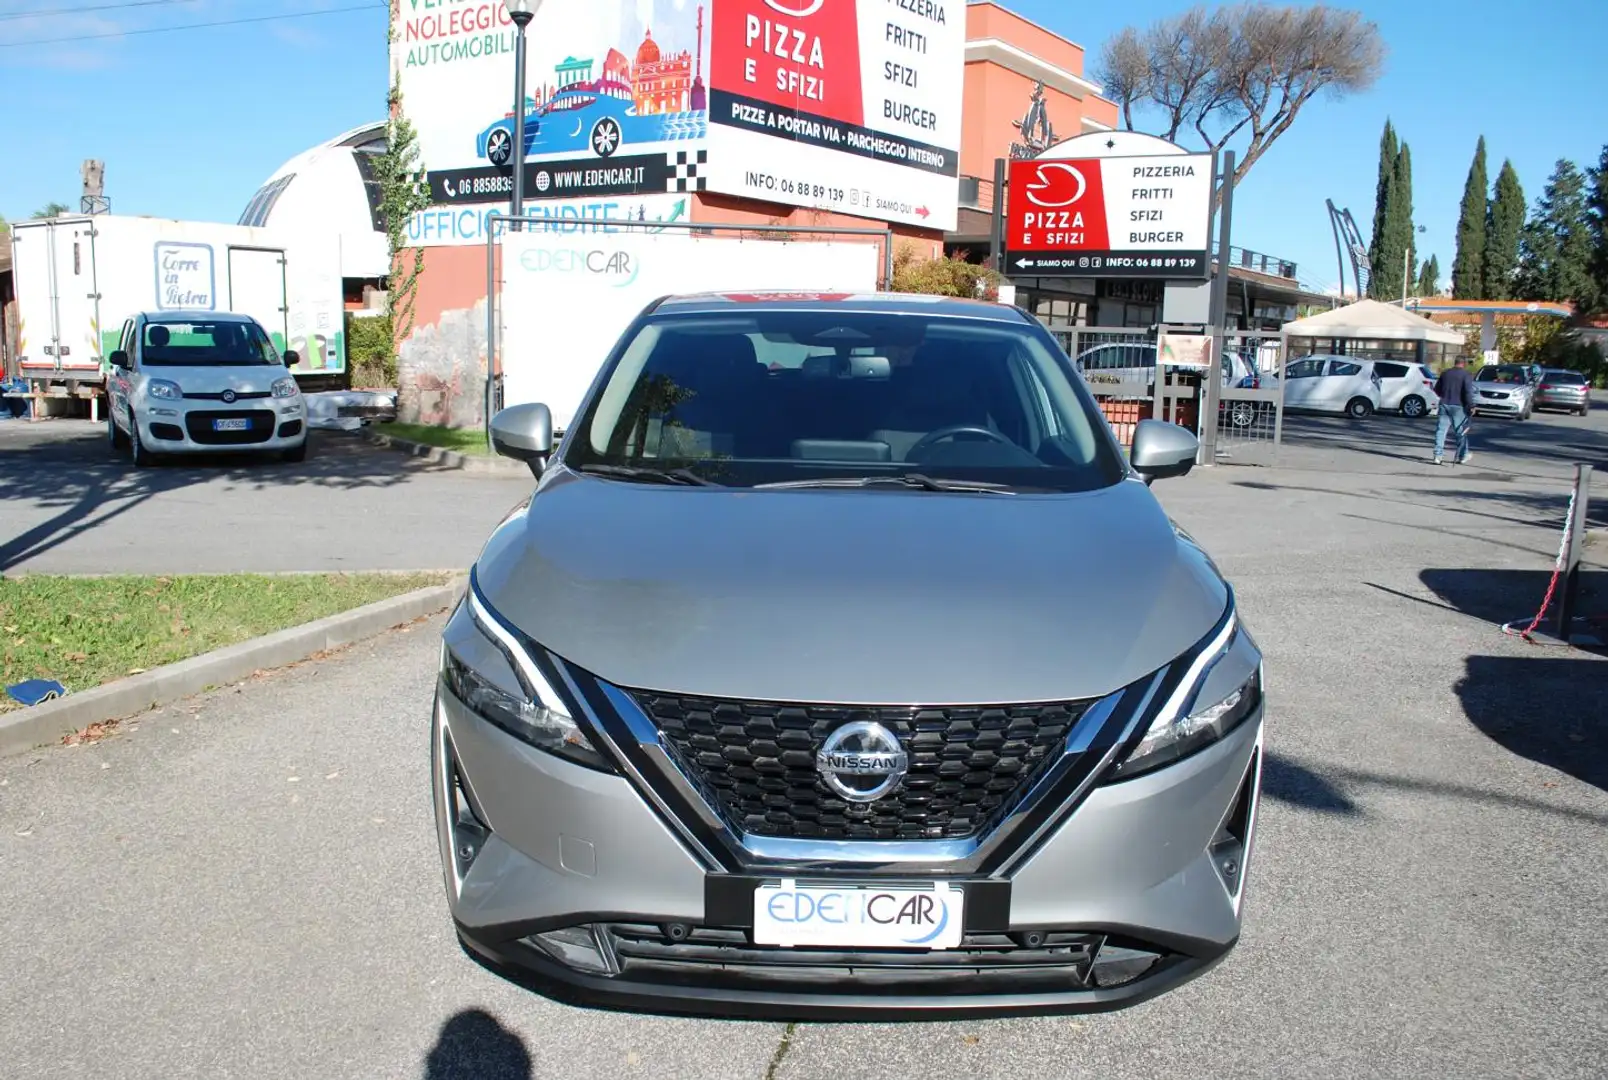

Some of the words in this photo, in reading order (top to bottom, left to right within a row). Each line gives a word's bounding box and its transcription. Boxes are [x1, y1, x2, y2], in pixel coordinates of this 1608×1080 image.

[887, 0, 945, 25] ZZERIA
[405, 30, 514, 68] AUTOMOBILI
[746, 14, 824, 69] PIZZA
[886, 22, 927, 54] FRITTI
[744, 58, 757, 82] E
[776, 68, 824, 100] SFIZI
[884, 61, 917, 88] SFIZI
[884, 99, 936, 131] BURGER
[731, 103, 765, 126] PIZZE
[767, 116, 776, 128] A
[778, 117, 820, 139] PORTAR
[822, 126, 840, 143] VIA
[847, 131, 906, 158] PARCHEGGIO
[908, 145, 944, 168] INTERNO
[554, 166, 645, 188] WWW.EDENCAR.IT
[1132, 165, 1195, 178] PIZZERIA
[459, 179, 471, 195] 06
[745, 171, 777, 190] INFO:
[781, 178, 793, 194] 06
[797, 182, 809, 196] 88
[813, 184, 824, 199] 89
[828, 187, 844, 203] 139
[876, 198, 898, 212] SIAMO
[900, 202, 912, 214] QUI
[1131, 188, 1173, 200] FRITTI
[408, 208, 504, 240] UFFICIO
[522, 202, 619, 234] ENDITE
[1024, 212, 1084, 229] PIZZA
[1130, 210, 1163, 222] SFIZI
[1023, 233, 1032, 244] E
[1046, 232, 1084, 244] SFIZI
[1129, 231, 1184, 243] BURGER
[520, 249, 631, 274] EDENCAR
[1037, 259, 1060, 267] SIAMO
[1061, 259, 1075, 268] QUI
[1106, 258, 1134, 268] INFO:
[1136, 258, 1148, 267] 06
[1151, 258, 1162, 267] 88
[1164, 258, 1176, 267] 89
[1179, 258, 1196, 267] 139
[827, 755, 897, 769] NISSAN
